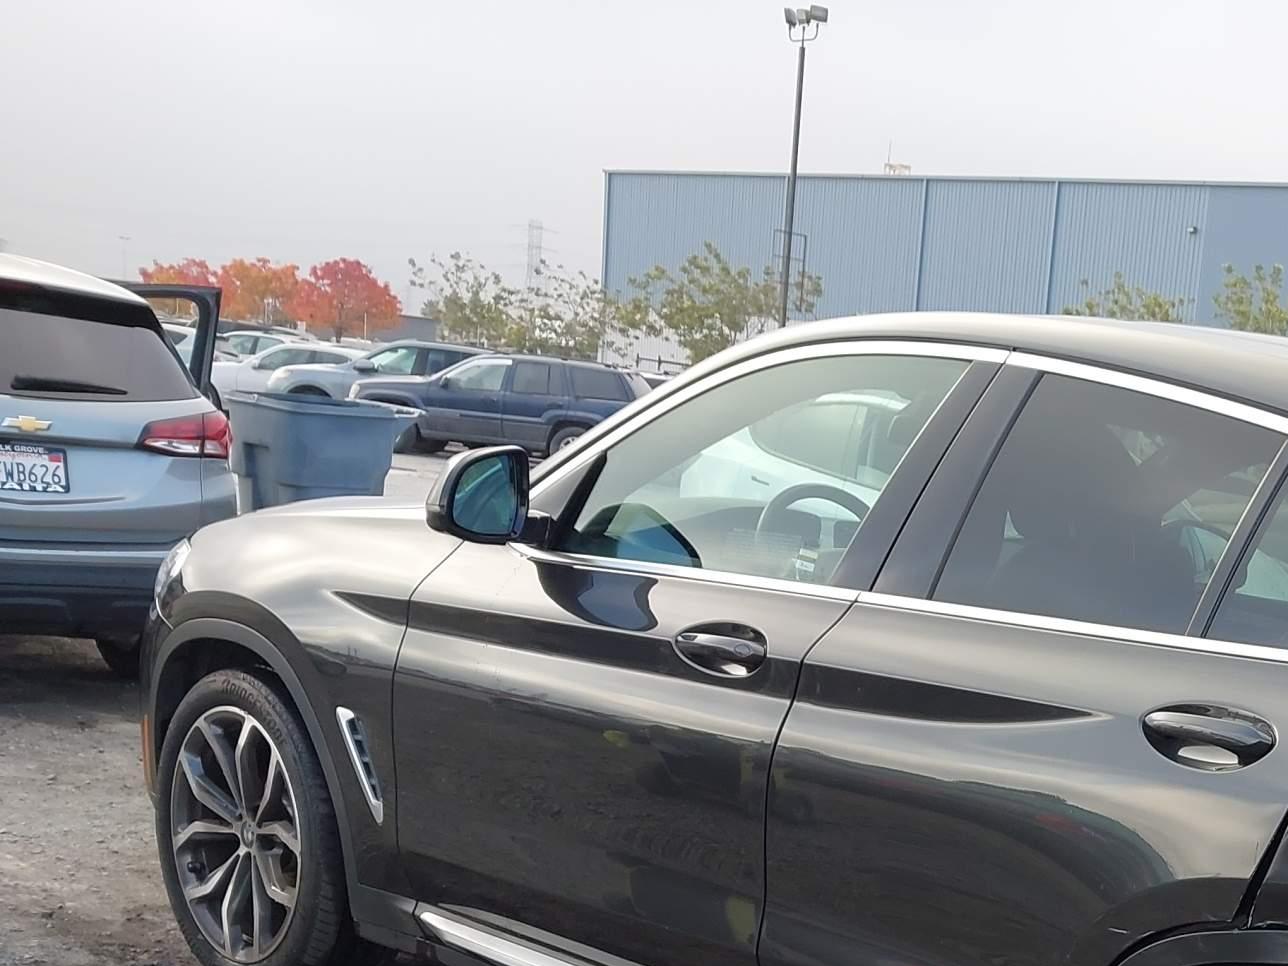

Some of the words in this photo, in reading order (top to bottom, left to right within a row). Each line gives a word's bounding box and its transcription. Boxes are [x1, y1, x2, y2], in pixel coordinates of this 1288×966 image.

[14, 445, 45, 454] GROVE
[0, 461, 61, 485] WB626
[0, 482, 65, 492] AITA
